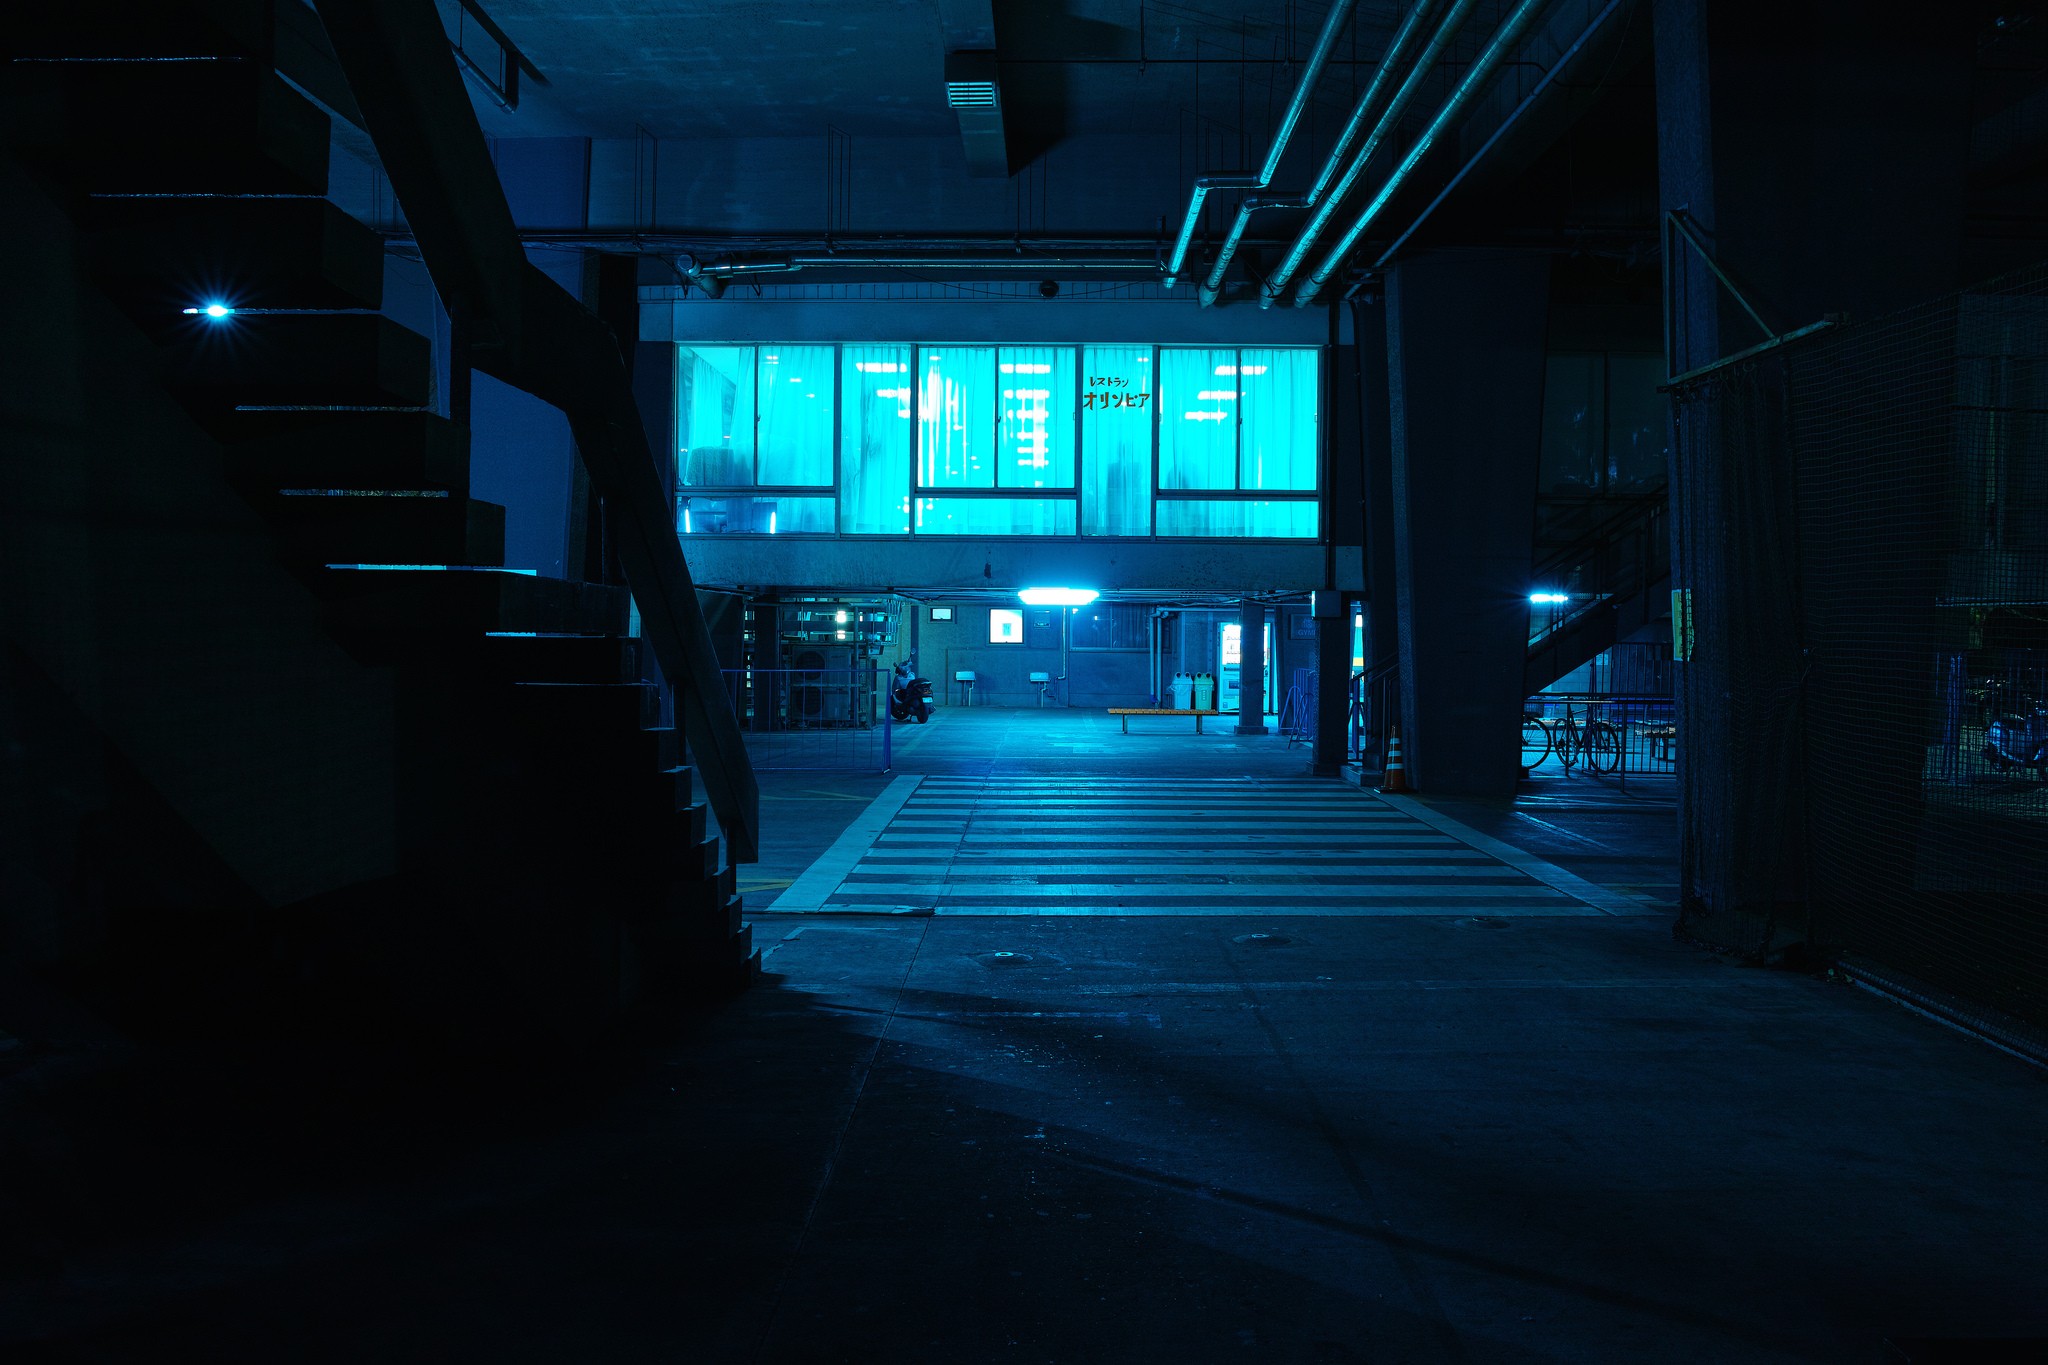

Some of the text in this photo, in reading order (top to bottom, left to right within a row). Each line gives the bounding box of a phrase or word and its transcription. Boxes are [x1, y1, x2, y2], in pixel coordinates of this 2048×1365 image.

[1089, 376, 1129, 388] レストラン
